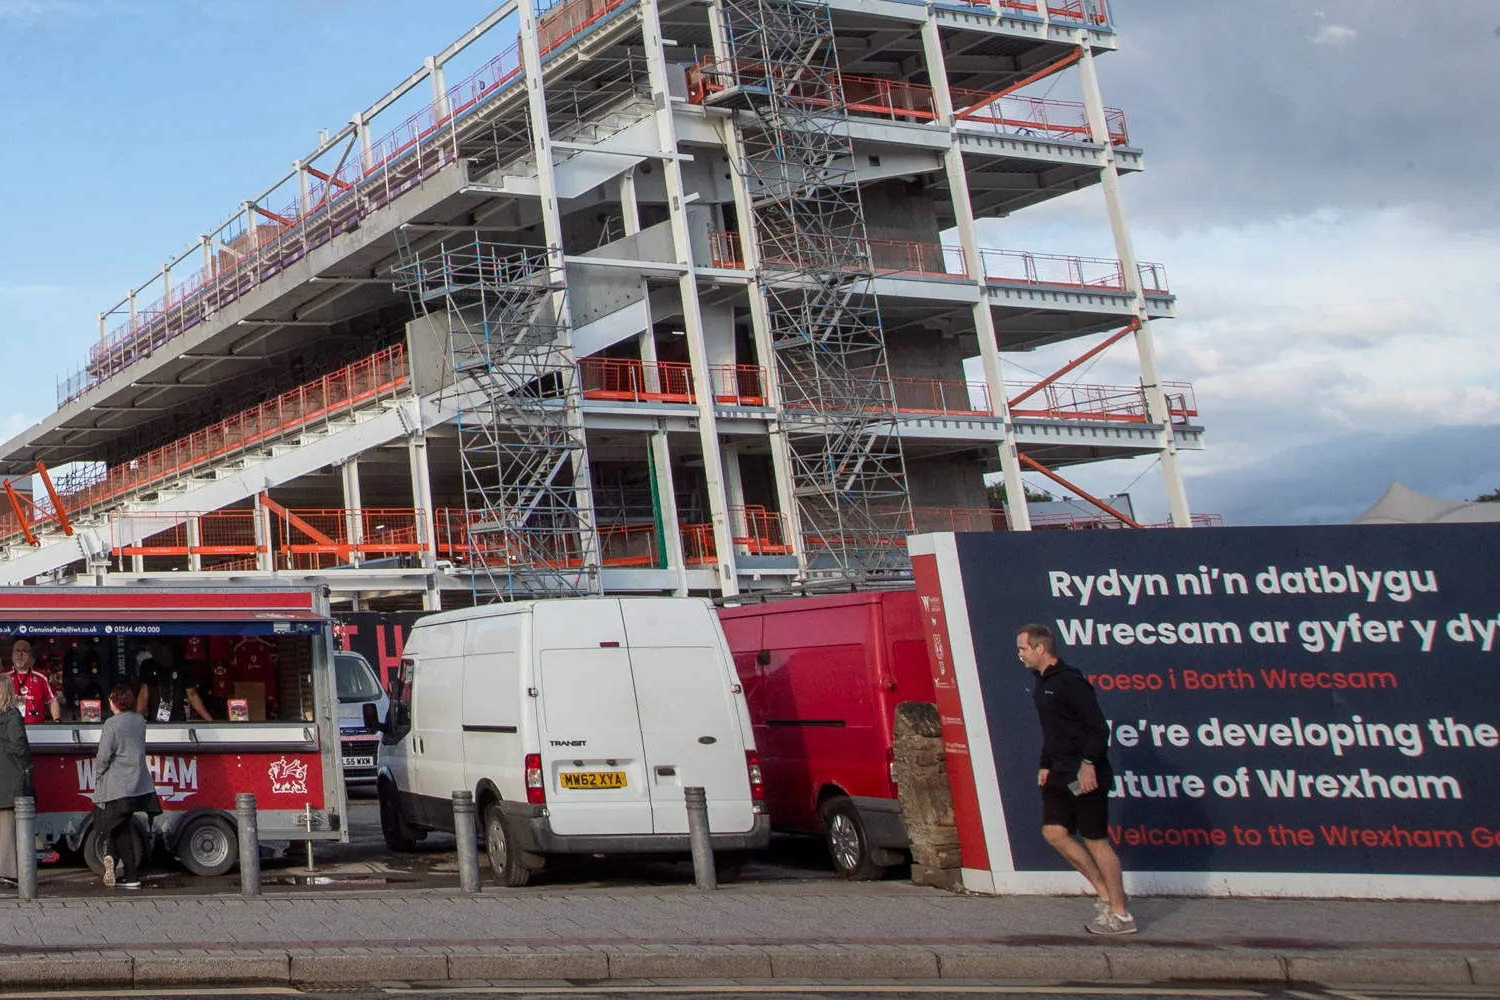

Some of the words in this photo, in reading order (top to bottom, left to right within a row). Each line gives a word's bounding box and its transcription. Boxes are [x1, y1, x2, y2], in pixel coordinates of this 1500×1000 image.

[1048, 568, 1170, 606] Rydyn
[1175, 565, 1249, 595] ni'n
[1255, 565, 1439, 602] datblygu
[114, 625, 133, 633] 01244
[133, 625, 147, 633] 400
[147, 625, 160, 633] 000
[1056, 619, 1243, 646] Wrecsam
[1248, 620, 1290, 643] ar
[1297, 612, 1404, 652] gyfer
[1410, 620, 1437, 651] y
[1446, 613, 1500, 651] dy
[1087, 672, 1163, 690] roeso
[1168, 668, 1177, 689] i
[1183, 668, 1255, 690] Borth
[1261, 668, 1398, 690] Wrecsam
[1197, 715, 1424, 756] developing
[1427, 717, 1500, 747] the
[76, 755, 198, 790] WHAM
[565, 774, 596, 786] MW62
[599, 774, 622, 785] XYA
[1108, 770, 1205, 798] uture
[1212, 766, 1251, 798] of
[1255, 768, 1463, 799] Wrexham
[1232, 825, 1262, 846] to
[1268, 823, 1315, 846] the
[1320, 824, 1465, 848] Wrexham
